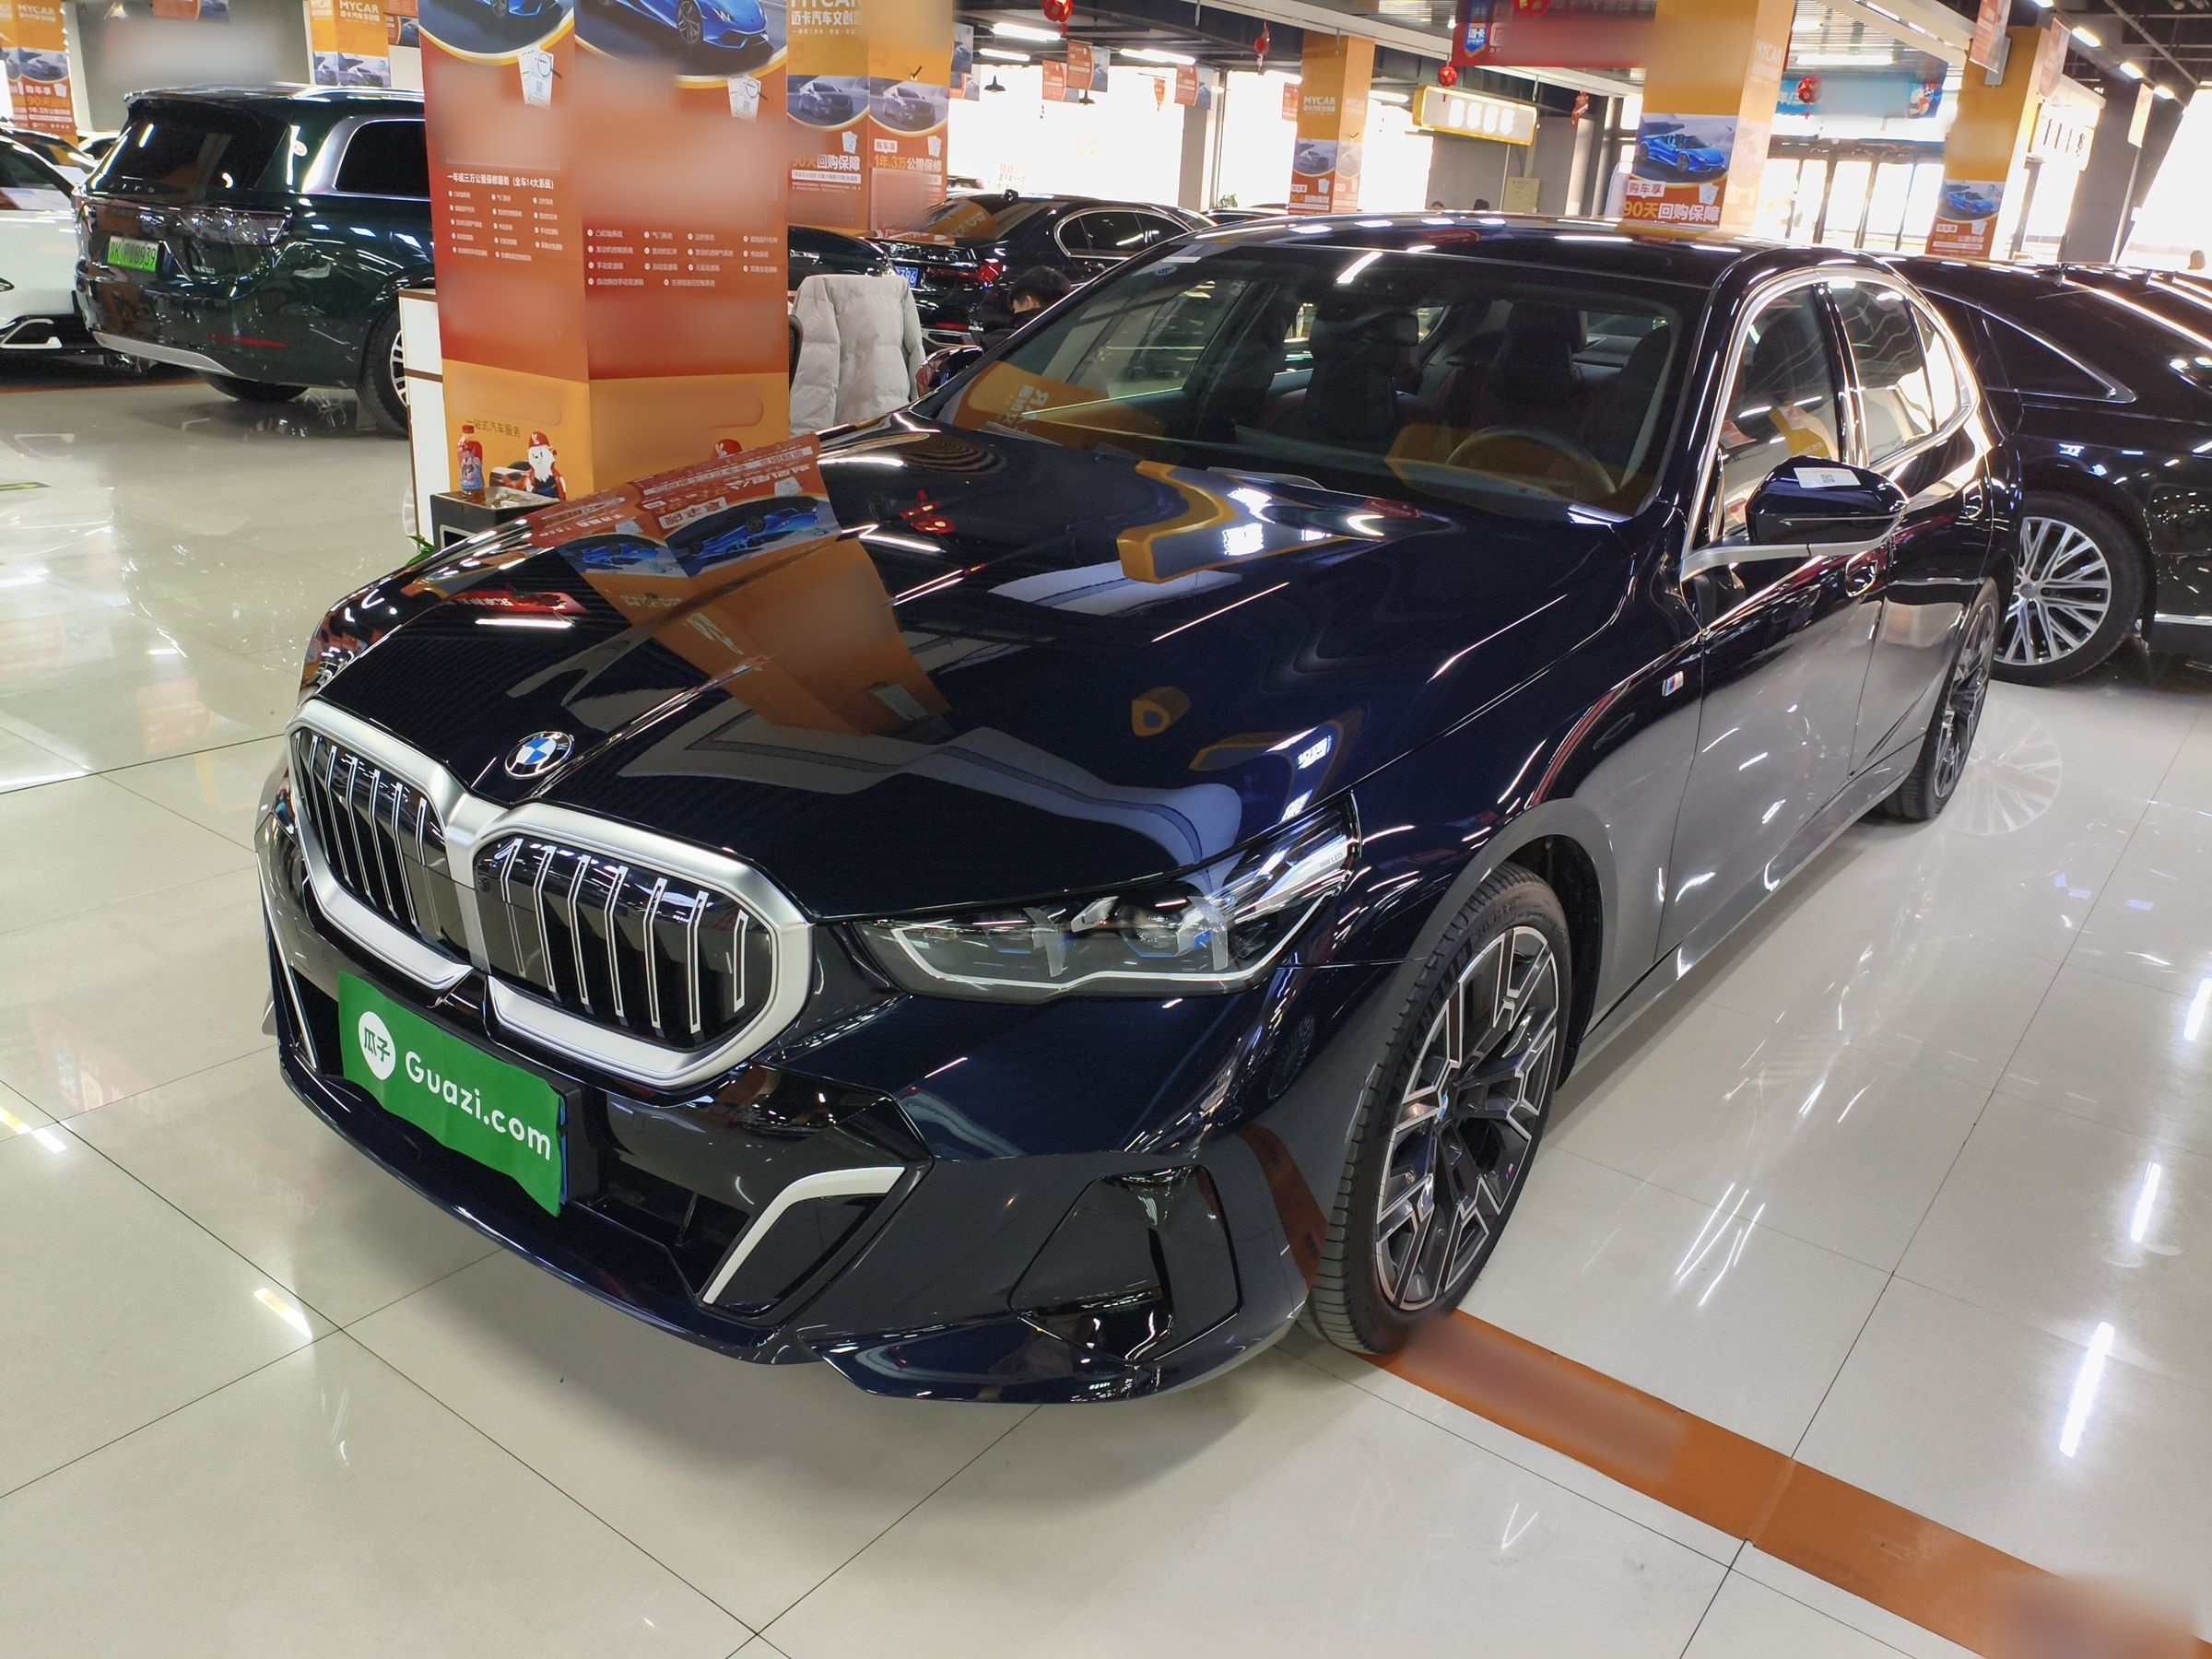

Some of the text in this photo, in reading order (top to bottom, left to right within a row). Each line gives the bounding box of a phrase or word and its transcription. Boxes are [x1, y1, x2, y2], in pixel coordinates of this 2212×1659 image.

[339, 0, 379, 14] MYCAR
[1303, 96, 1335, 105] MYCAR
[792, 154, 861, 171] 90天回购保障
[1628, 182, 1662, 195] 购车享
[1623, 200, 1721, 222] 90天回购保障
[363, 1026, 391, 1063] 瓜子
[405, 1050, 552, 1162] Guazi.com
